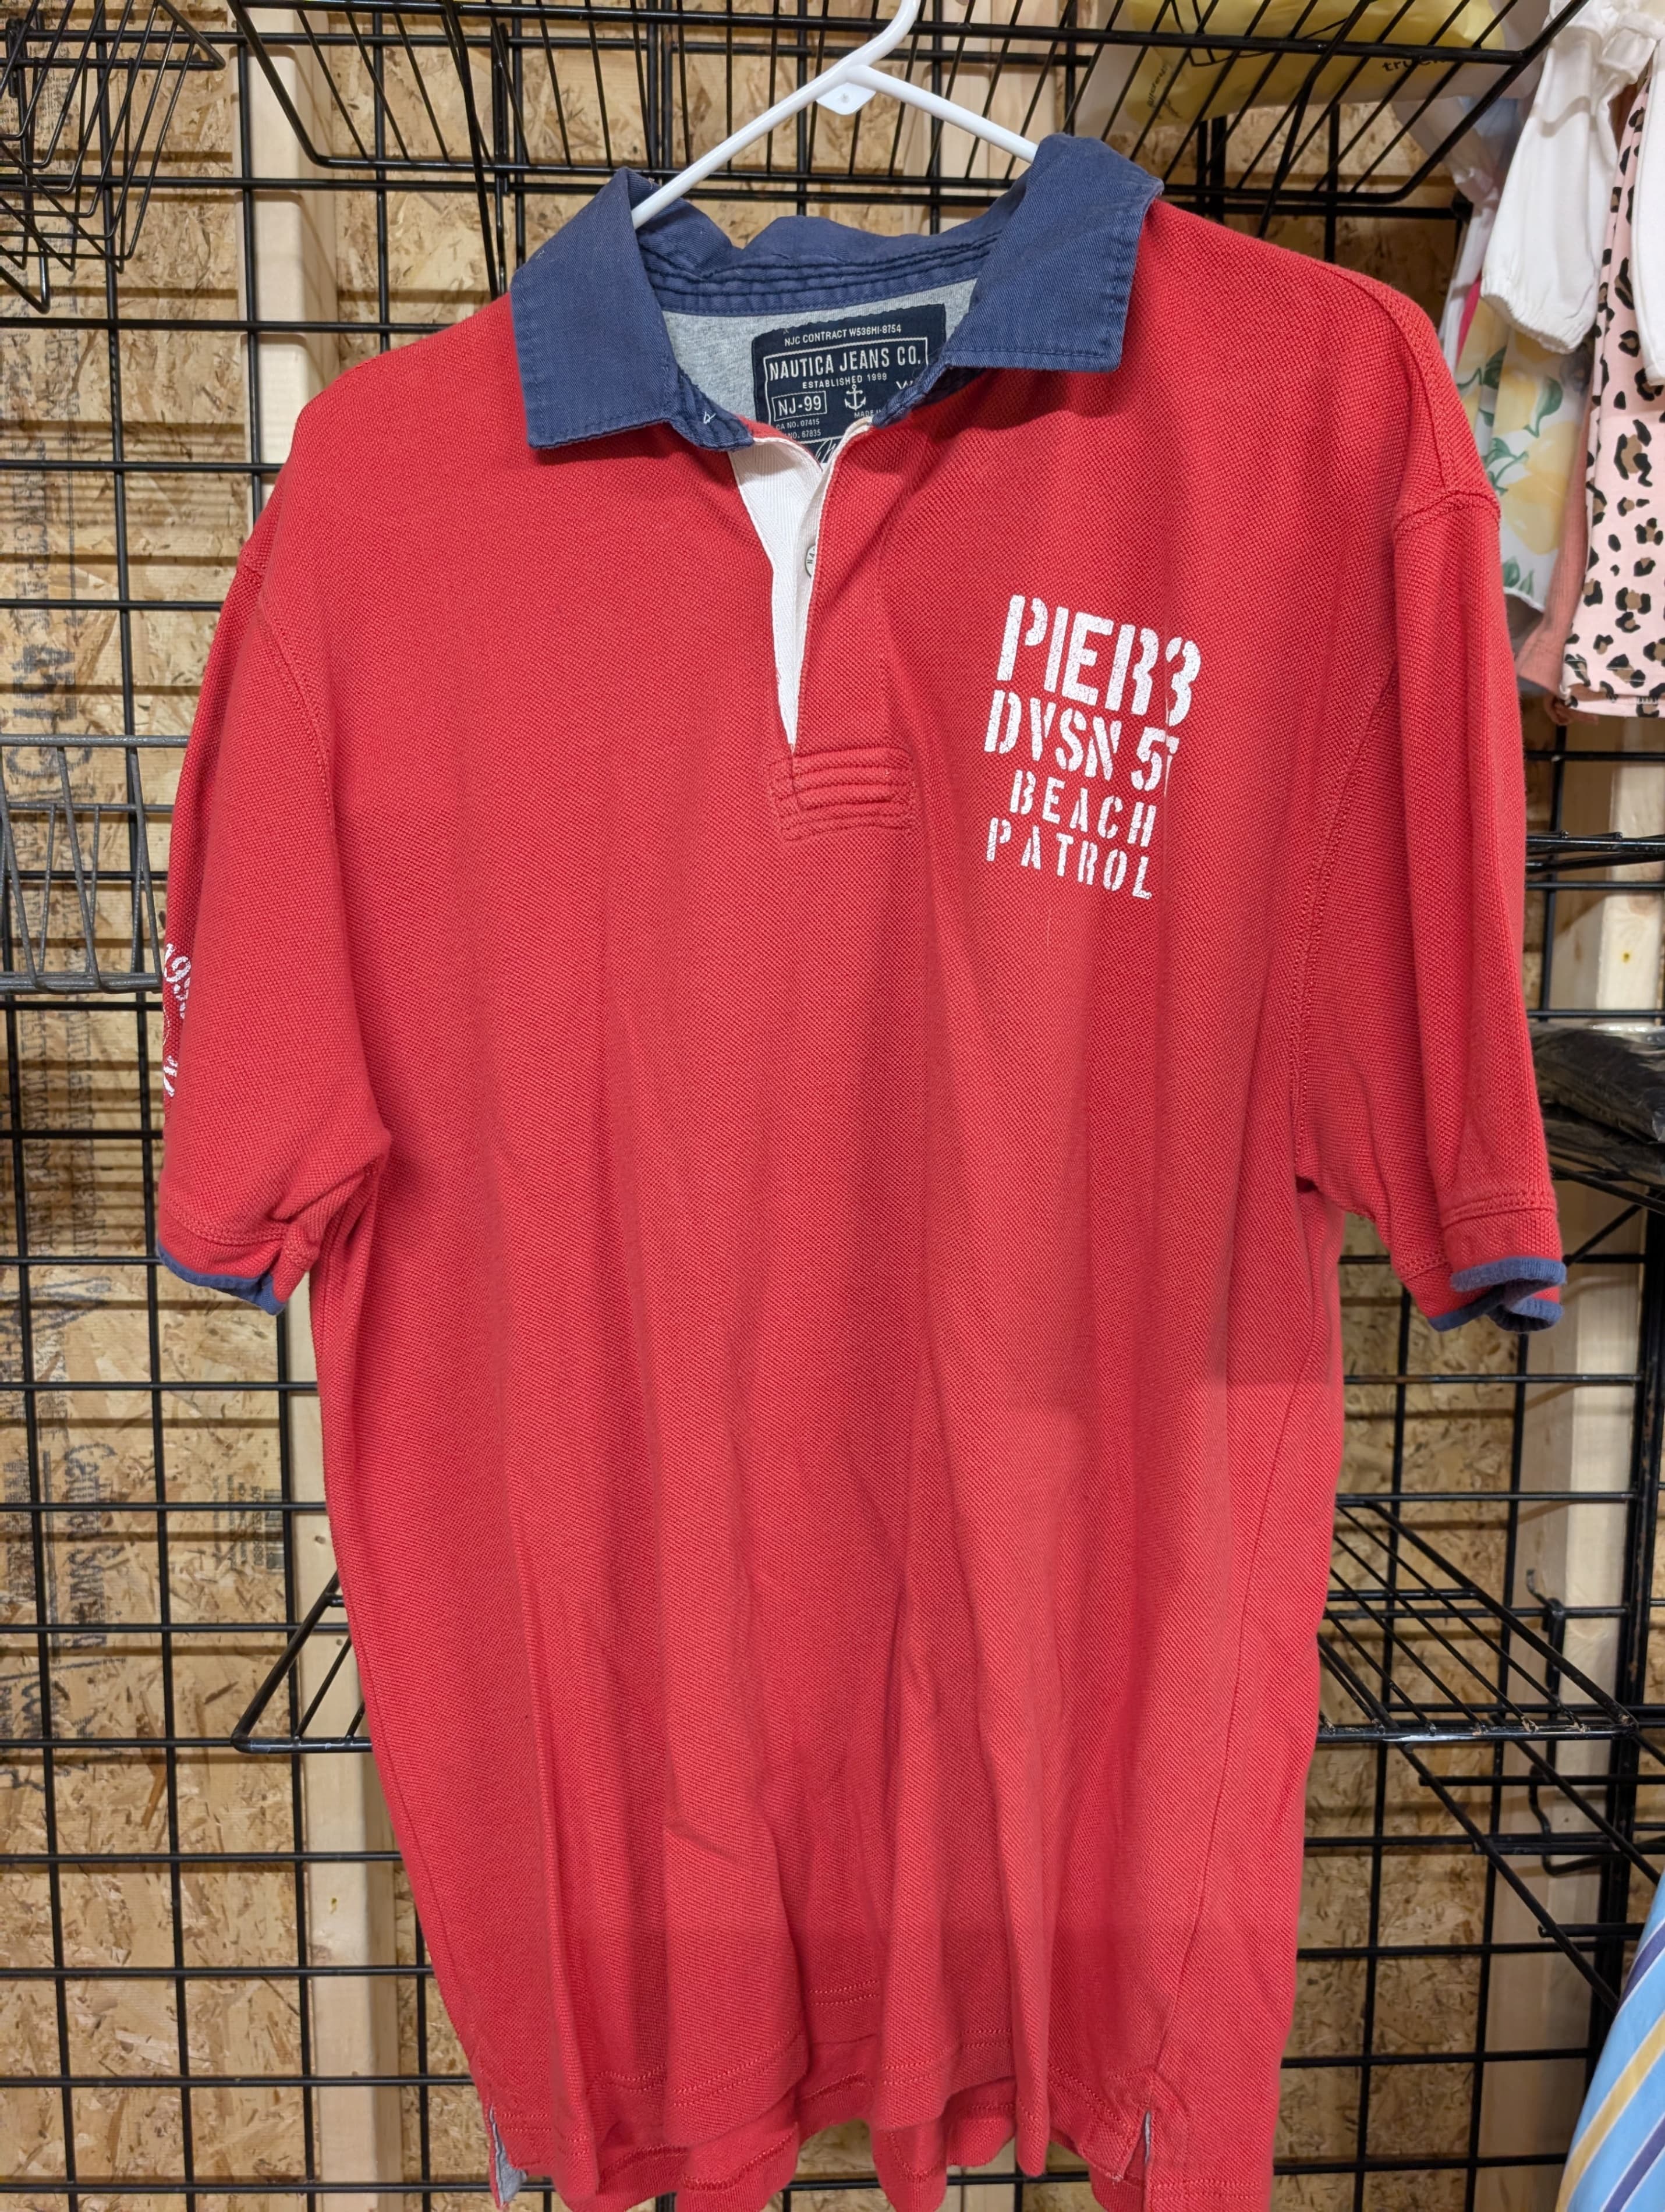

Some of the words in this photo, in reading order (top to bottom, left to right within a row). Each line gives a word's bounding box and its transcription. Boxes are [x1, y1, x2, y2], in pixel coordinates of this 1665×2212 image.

[784, 338, 800, 346] NJC
[803, 329, 846, 343] CONTRACT
[769, 355, 834, 381] NAUTICA
[839, 348, 890, 371] JEANS
[897, 346, 921, 366] CO.
[802, 375, 862, 389] ESTABLISHED
[778, 395, 821, 416] NJ-99
[854, 410, 874, 419] MADE
[800, 418, 820, 427] 07415
[984, 689, 1122, 781] DVSN
[1010, 769, 1157, 848] BEACH
[985, 817, 1153, 900] PATROL
